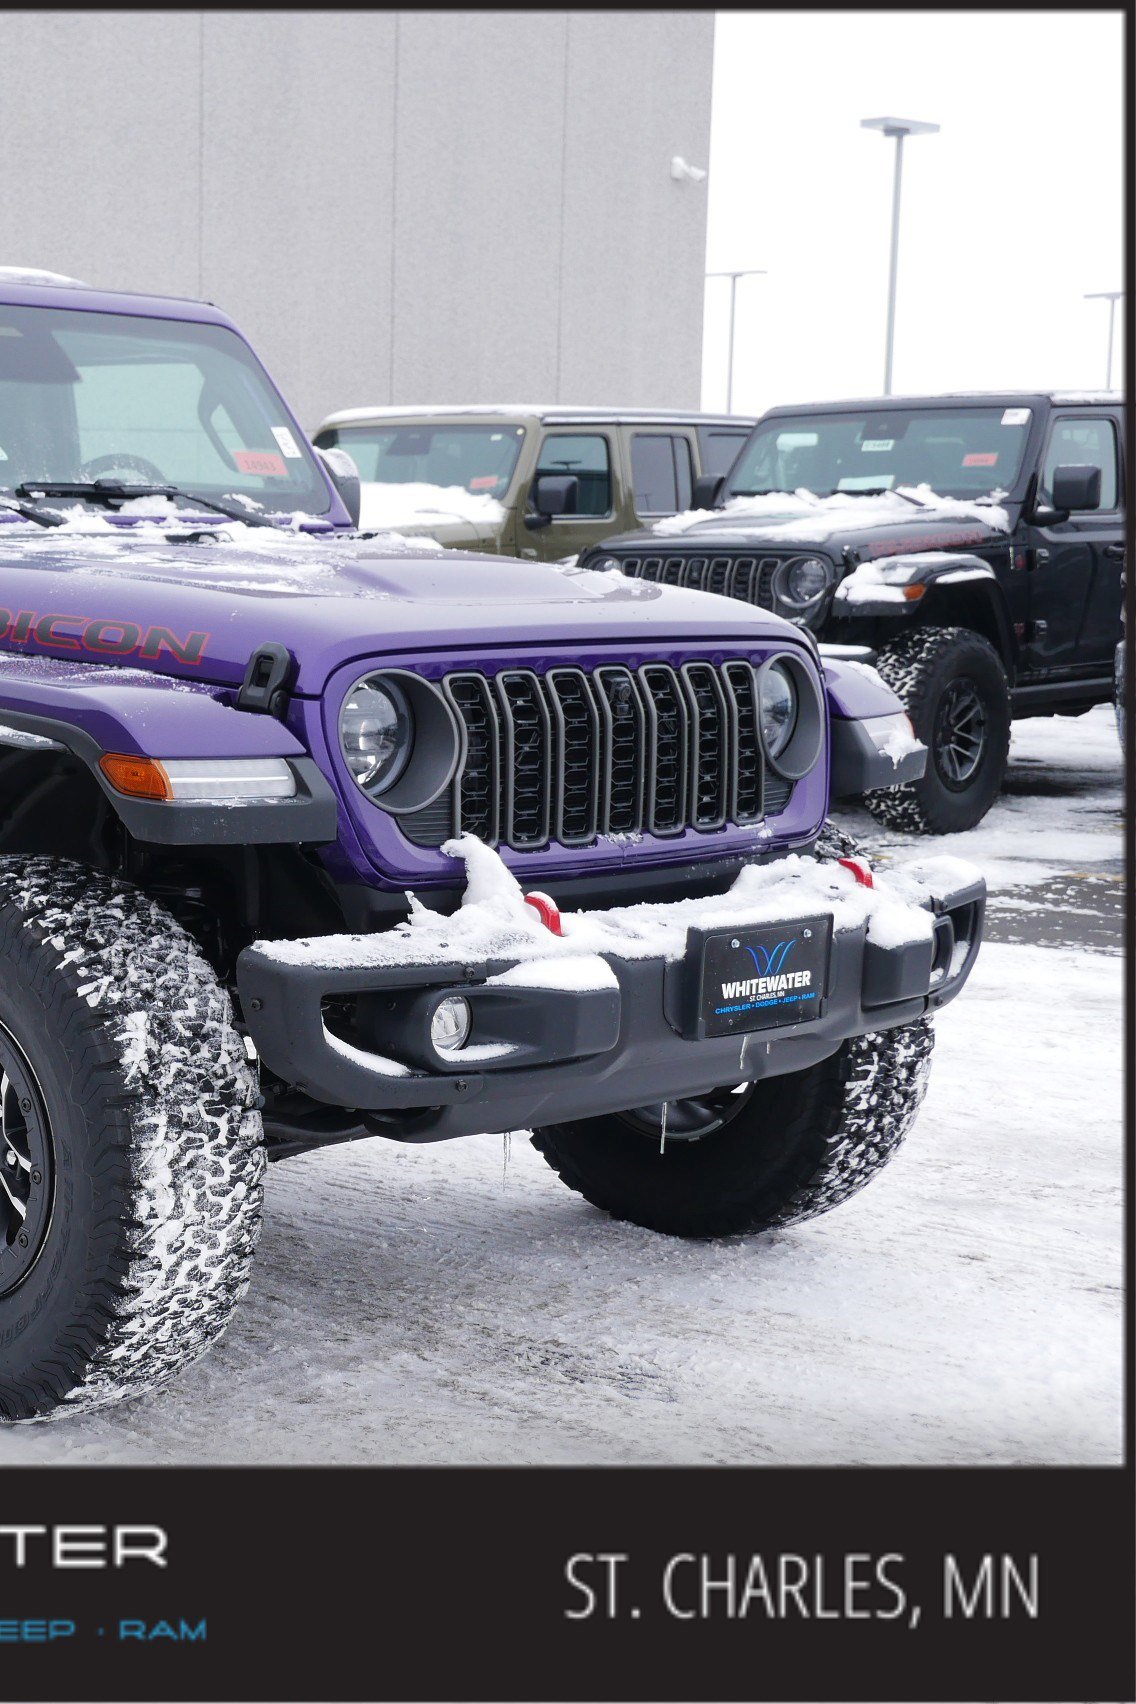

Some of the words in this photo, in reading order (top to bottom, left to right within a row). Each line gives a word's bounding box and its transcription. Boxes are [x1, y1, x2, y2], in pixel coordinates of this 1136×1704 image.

[721, 970, 811, 1000] WHITEWATER
[715, 1003, 751, 1015] CHRYSLER
[755, 999, 778, 1008] DODGE
[782, 995, 798, 1004] JEEP
[801, 992, 816, 1000] RAM
